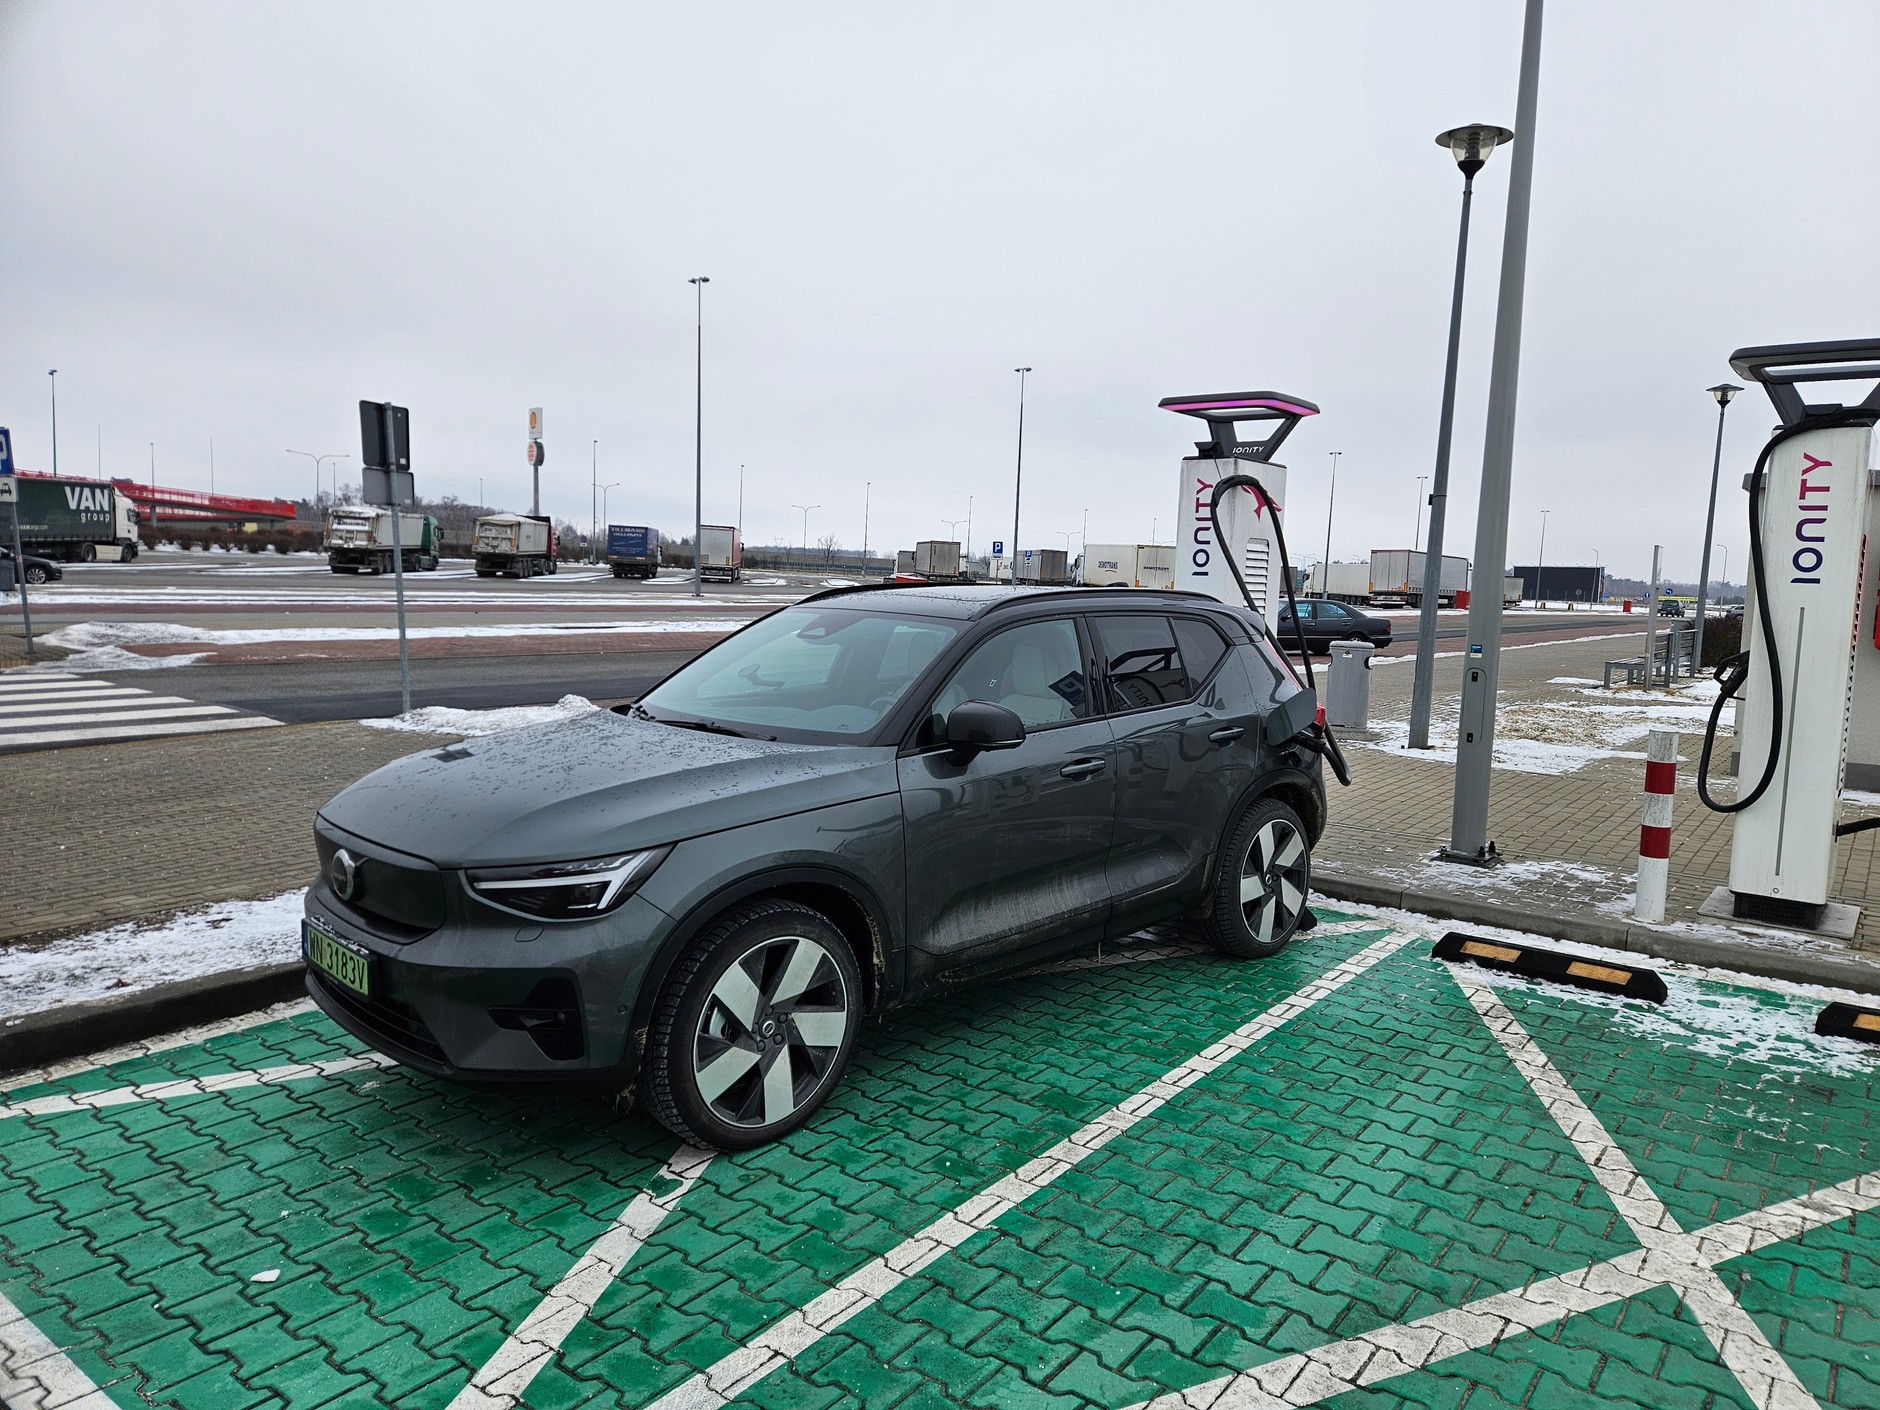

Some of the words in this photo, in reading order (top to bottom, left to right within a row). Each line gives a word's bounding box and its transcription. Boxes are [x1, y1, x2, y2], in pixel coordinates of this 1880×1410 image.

[1232, 446, 1265, 454] IONITY
[64, 486, 109, 511] VAN
[81, 513, 110, 523] group
[1192, 478, 1214, 576] IONITY
[1790, 452, 1833, 585] IONITY
[995, 543, 1001, 552] P
[309, 928, 323, 965] WN
[327, 942, 365, 990] 3183V
